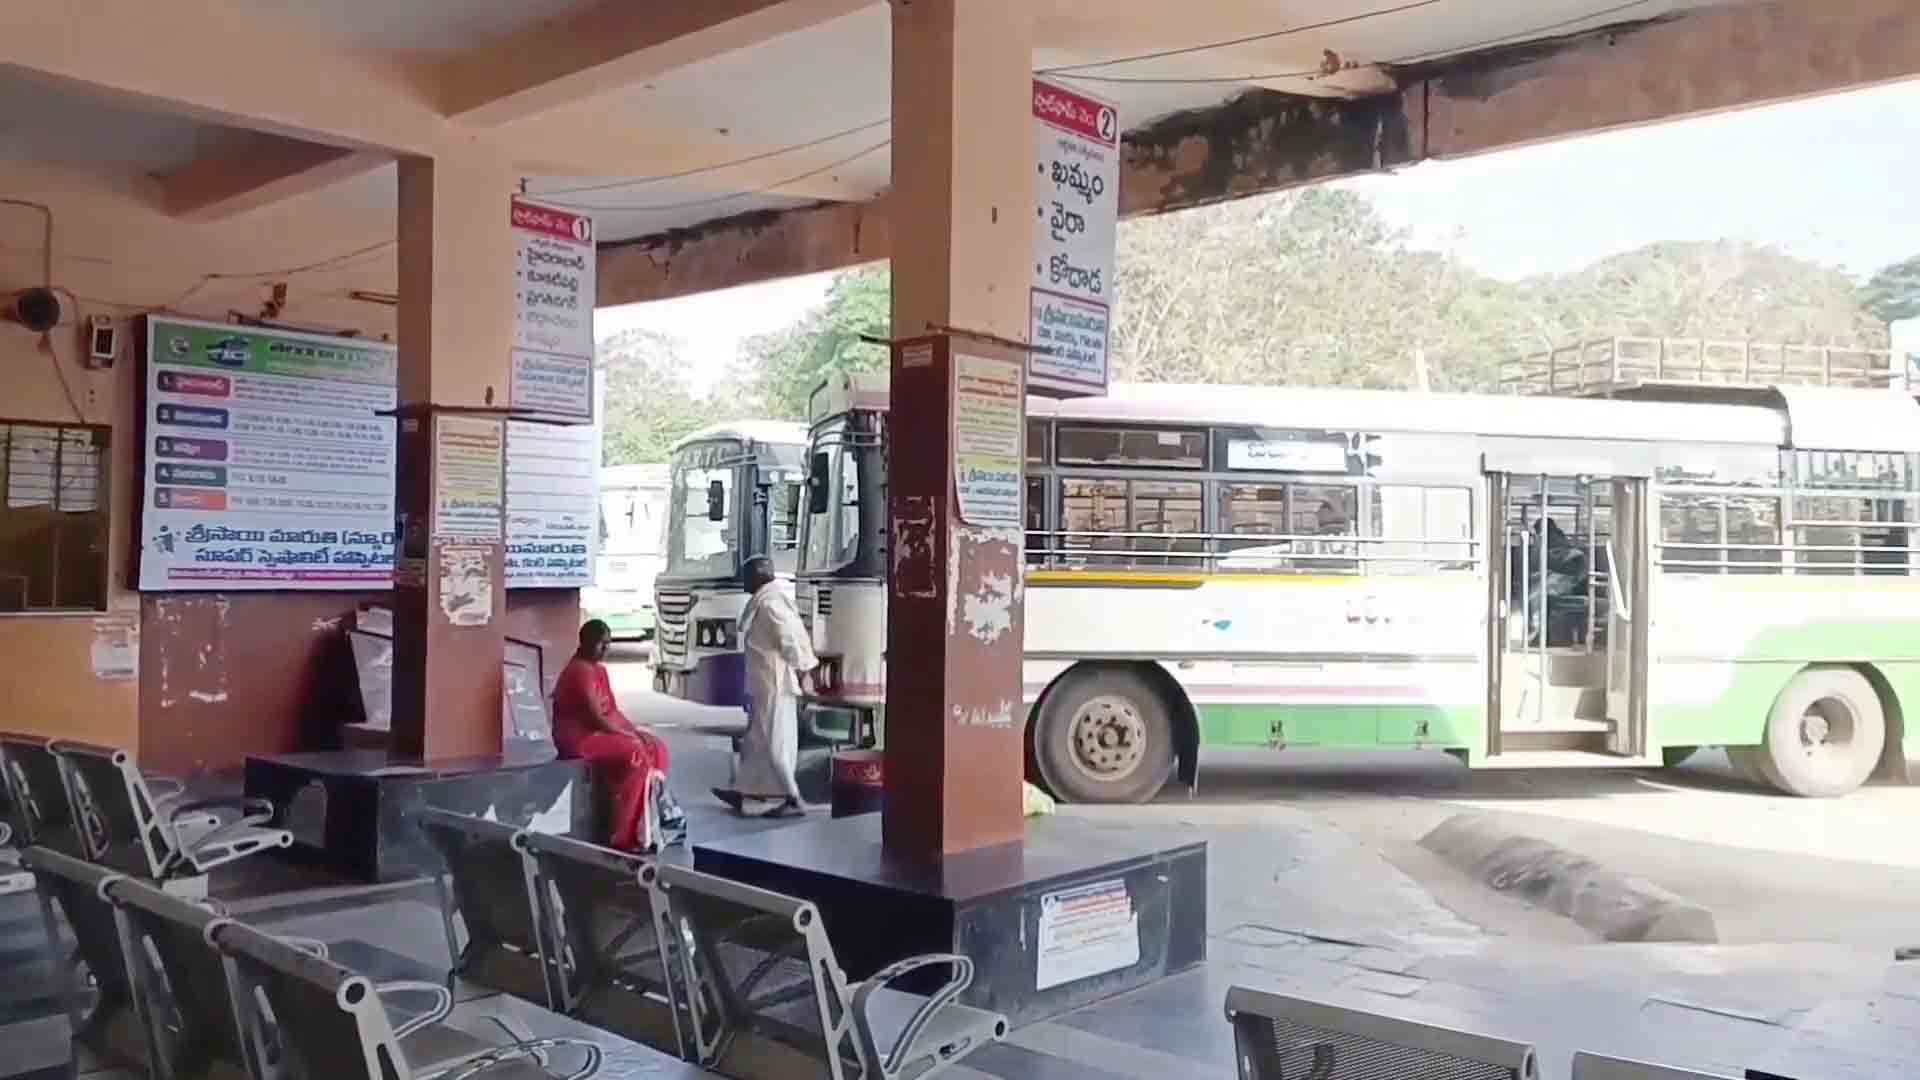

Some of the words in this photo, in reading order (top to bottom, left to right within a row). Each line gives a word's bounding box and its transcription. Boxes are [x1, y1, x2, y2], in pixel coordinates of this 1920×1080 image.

[1102, 109, 1112, 137] 2
[1052, 160, 1104, 205] ఖమ్మం
[1051, 200, 1085, 242] వైరా
[1050, 253, 1102, 294] కోదాడ
